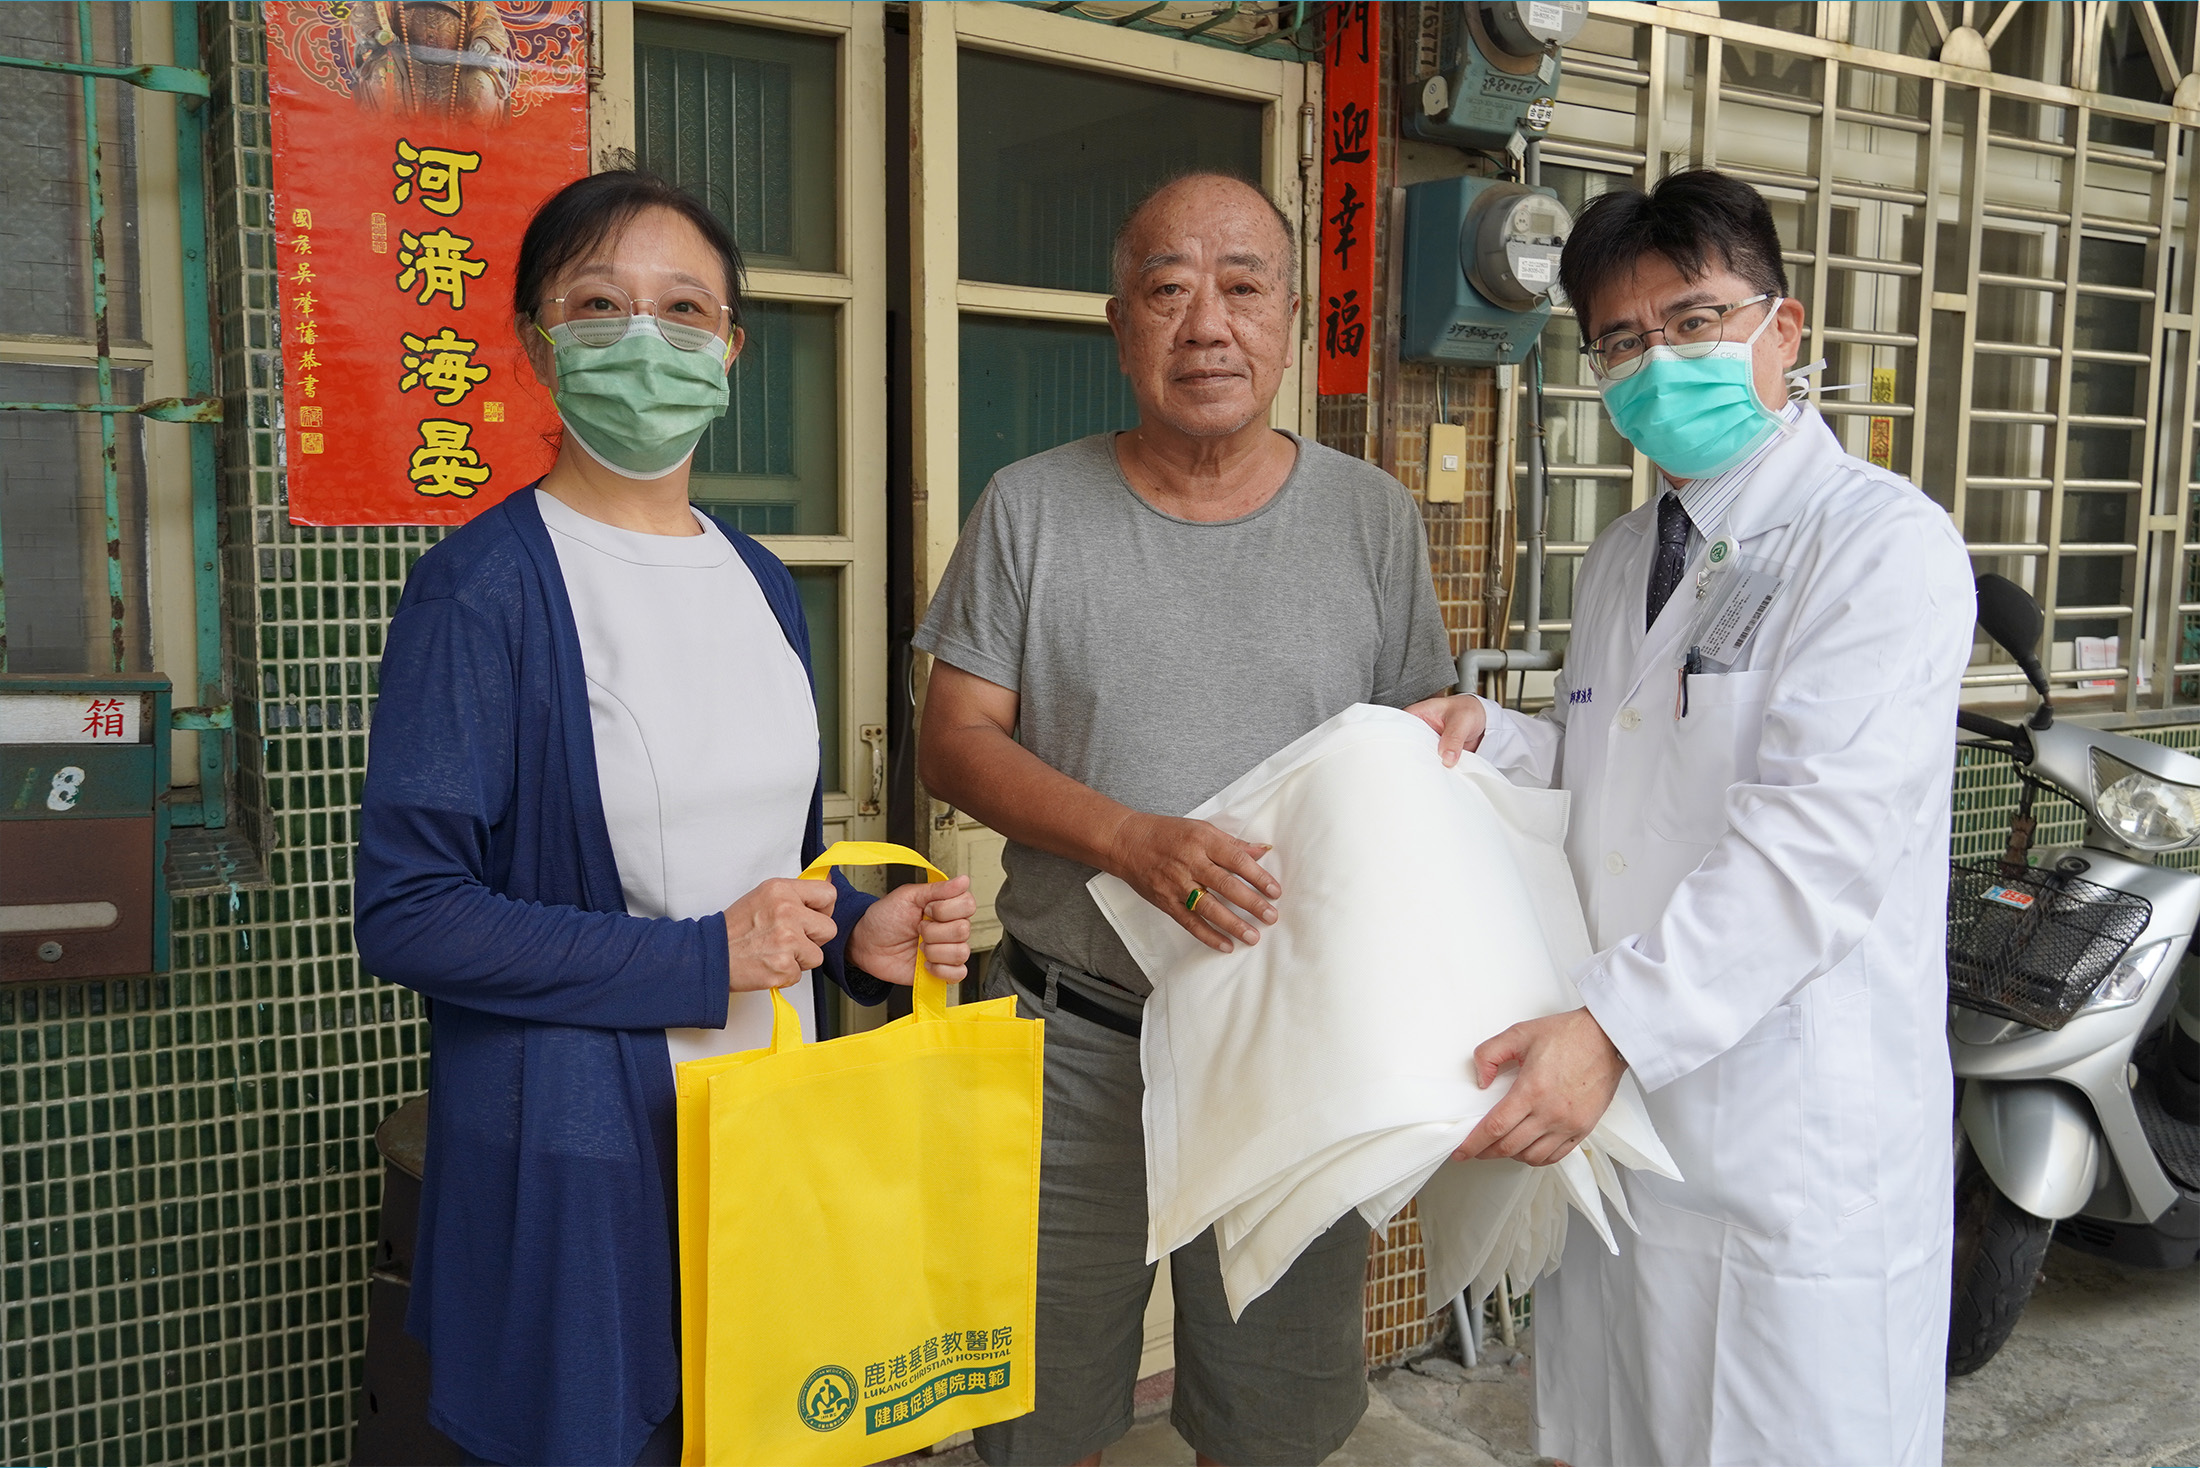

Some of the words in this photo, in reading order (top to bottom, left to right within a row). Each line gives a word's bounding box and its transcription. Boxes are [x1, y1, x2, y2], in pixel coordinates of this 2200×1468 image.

[82, 698, 125, 738] 箱
[864, 1326, 1012, 1388] 鹿港基督教醫院
[864, 1379, 908, 1399] LUKANG
[909, 1356, 954, 1384] CHRISTIAN
[956, 1348, 1011, 1362] HOSPITAL
[874, 1368, 1005, 1428] 健康促進醫院典範
